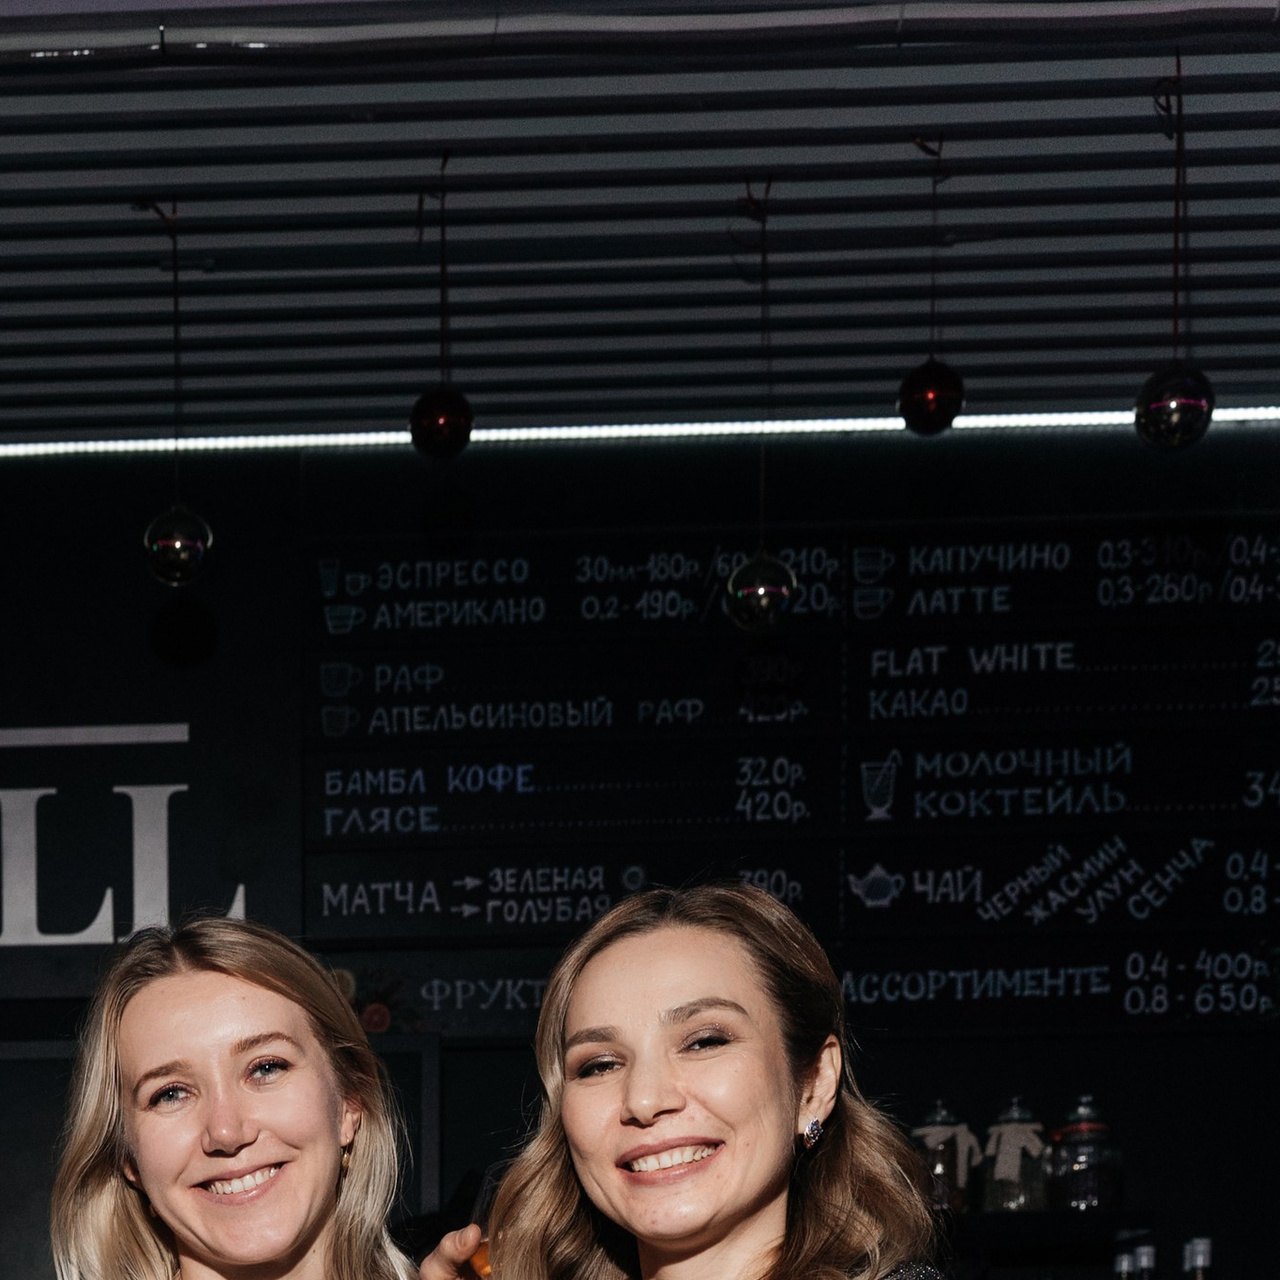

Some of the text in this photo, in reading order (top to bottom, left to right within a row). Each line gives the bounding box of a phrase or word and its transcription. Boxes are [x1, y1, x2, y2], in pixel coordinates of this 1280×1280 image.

[376, 556, 531, 591] ЭСПРЕССО
[908, 540, 1072, 575] КАПУЧИНО
[372, 595, 547, 630] АМЕРИКАНО
[906, 583, 1013, 616] ЛАТТЕ
[373, 662, 446, 694] РАФ
[869, 645, 949, 678] FLAT
[967, 641, 1078, 675] WHITE
[367, 694, 615, 736] АПЕЛЬСИНОВЫЙ
[637, 697, 705, 726] РАФ
[867, 687, 970, 720] КАКАО
[913, 741, 1134, 780] МОЛОЧНЫЙ
[323, 766, 428, 797] БАМБЛ
[446, 763, 538, 795] КОФЕ
[913, 779, 1128, 820] КОКТЕЙЛЬ
[323, 805, 442, 837] ГЛЯСЕ
[911, 865, 983, 904] ЧАЙ
[975, 843, 1072, 922] ЧЕРНЫЙ
[1022, 834, 1128, 927] ЖАСМИН
[1073, 857, 1145, 925] УЛУН
[1126, 836, 1216, 921] СЕНЧА
[322, 880, 442, 917] МАТЧА
[485, 896, 612, 924] ГОЛУБАЯ
